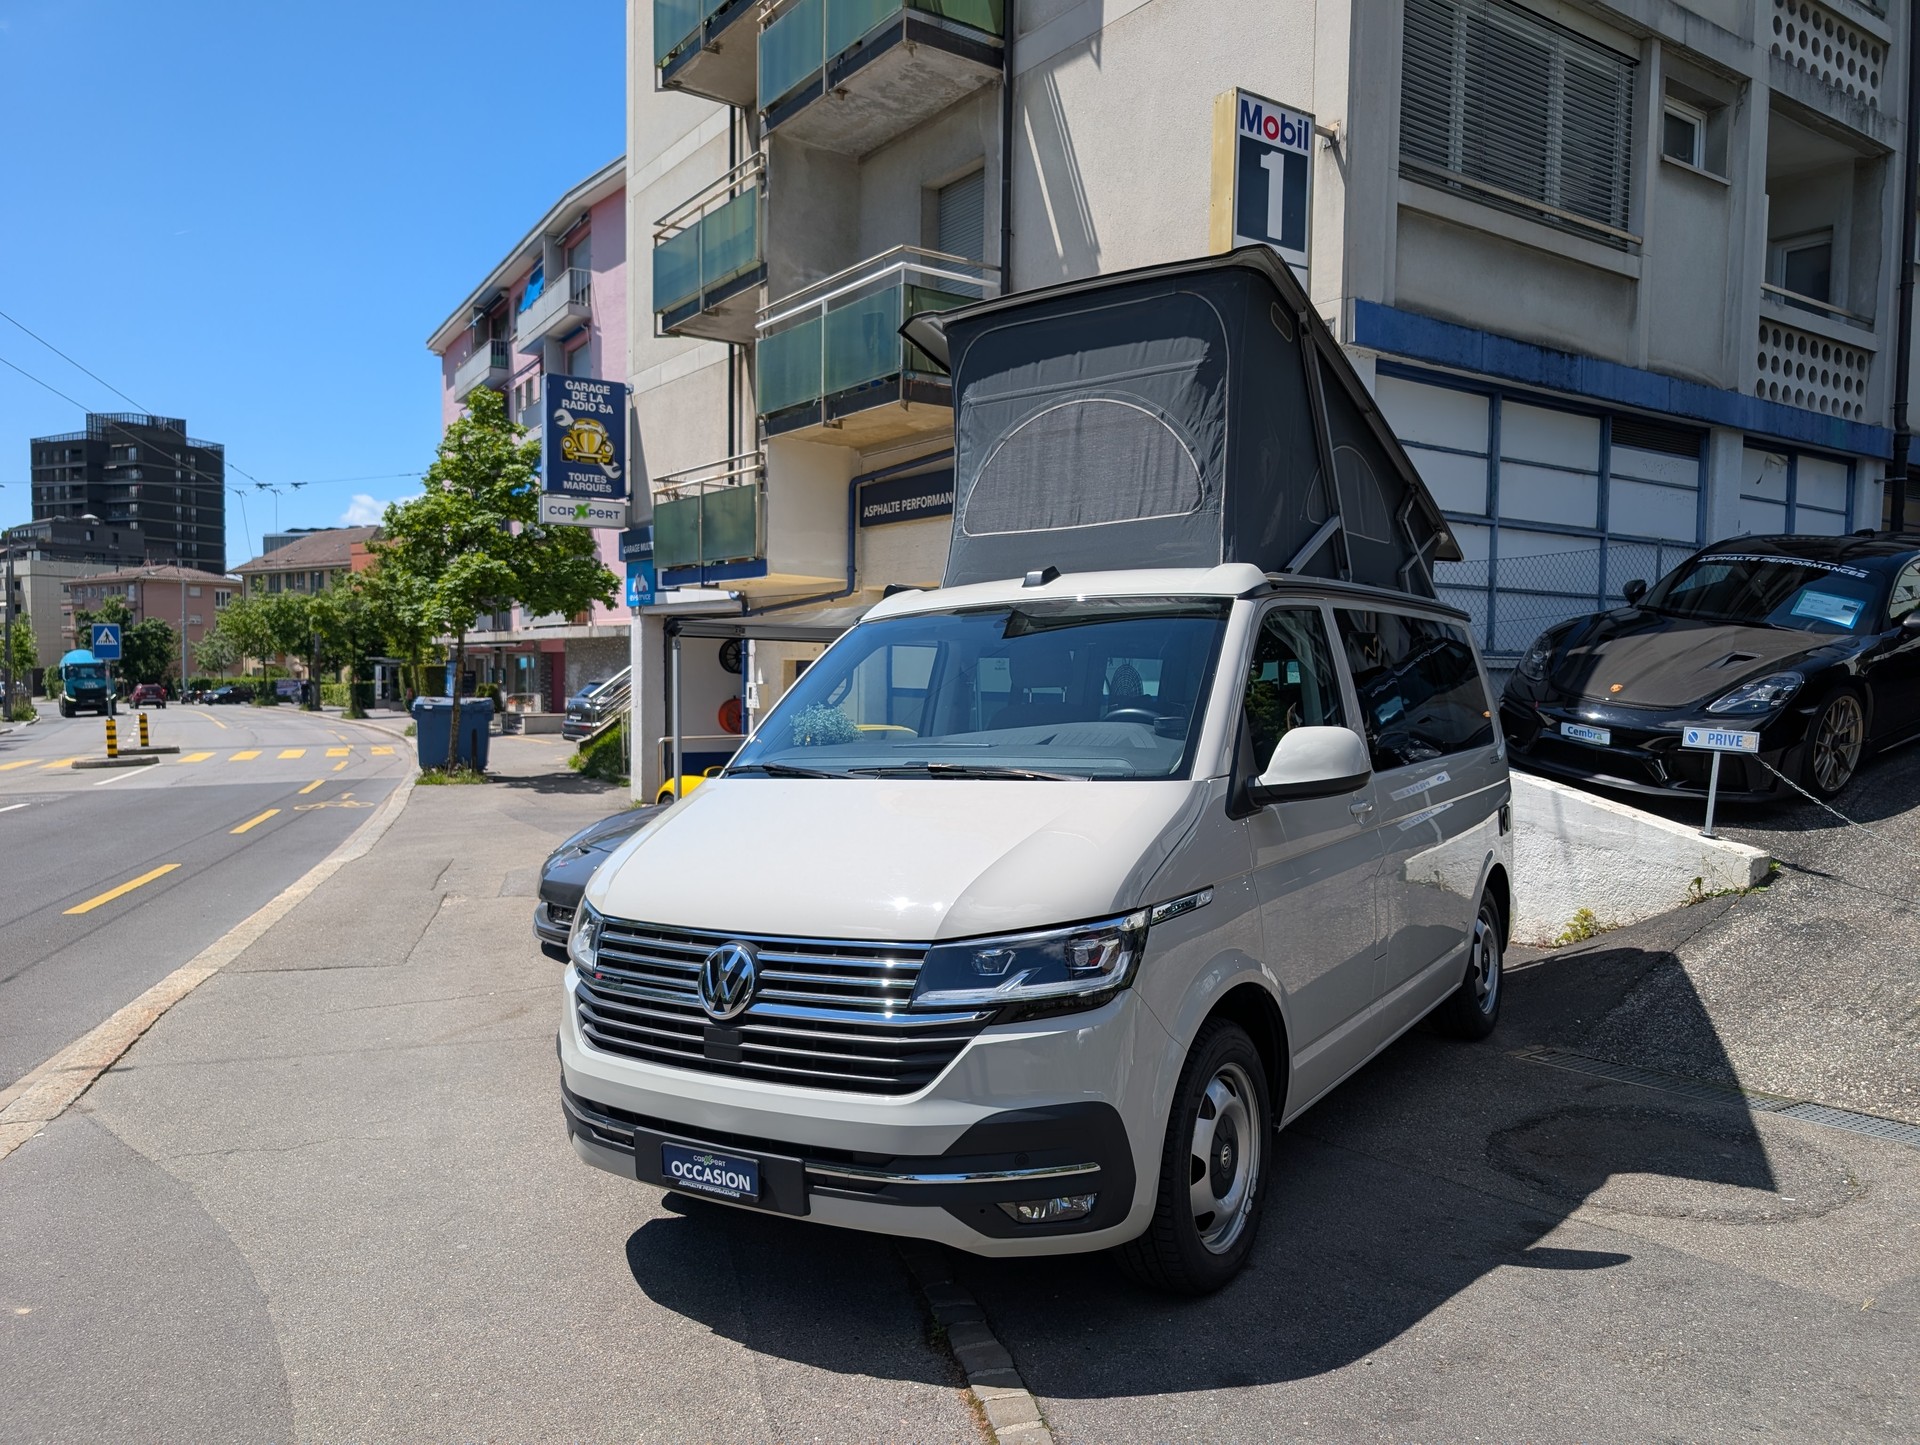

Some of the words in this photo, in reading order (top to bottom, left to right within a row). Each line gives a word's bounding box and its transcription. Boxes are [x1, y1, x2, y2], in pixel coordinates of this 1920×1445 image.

[1240, 99, 1309, 151] Mobil
[1260, 150, 1285, 241] 1
[565, 380, 611, 395] GARAGE
[572, 391, 587, 402] DE
[589, 393, 604, 403] LA
[561, 399, 597, 412] RADIO
[598, 404, 614, 415] SA
[568, 472, 607, 484] TOUTES
[563, 481, 612, 493] MARQUES
[864, 501, 901, 517] ASPHALTE
[623, 543, 640, 554] GARAGE
[1698, 555, 1760, 563] ASPHALTE
[1760, 557, 1867, 579] PERFORMANCES
[1567, 726, 1603, 741] Cembra
[1707, 732, 1743, 747] PRIVE
[671, 1160, 751, 1191] OCCASION
